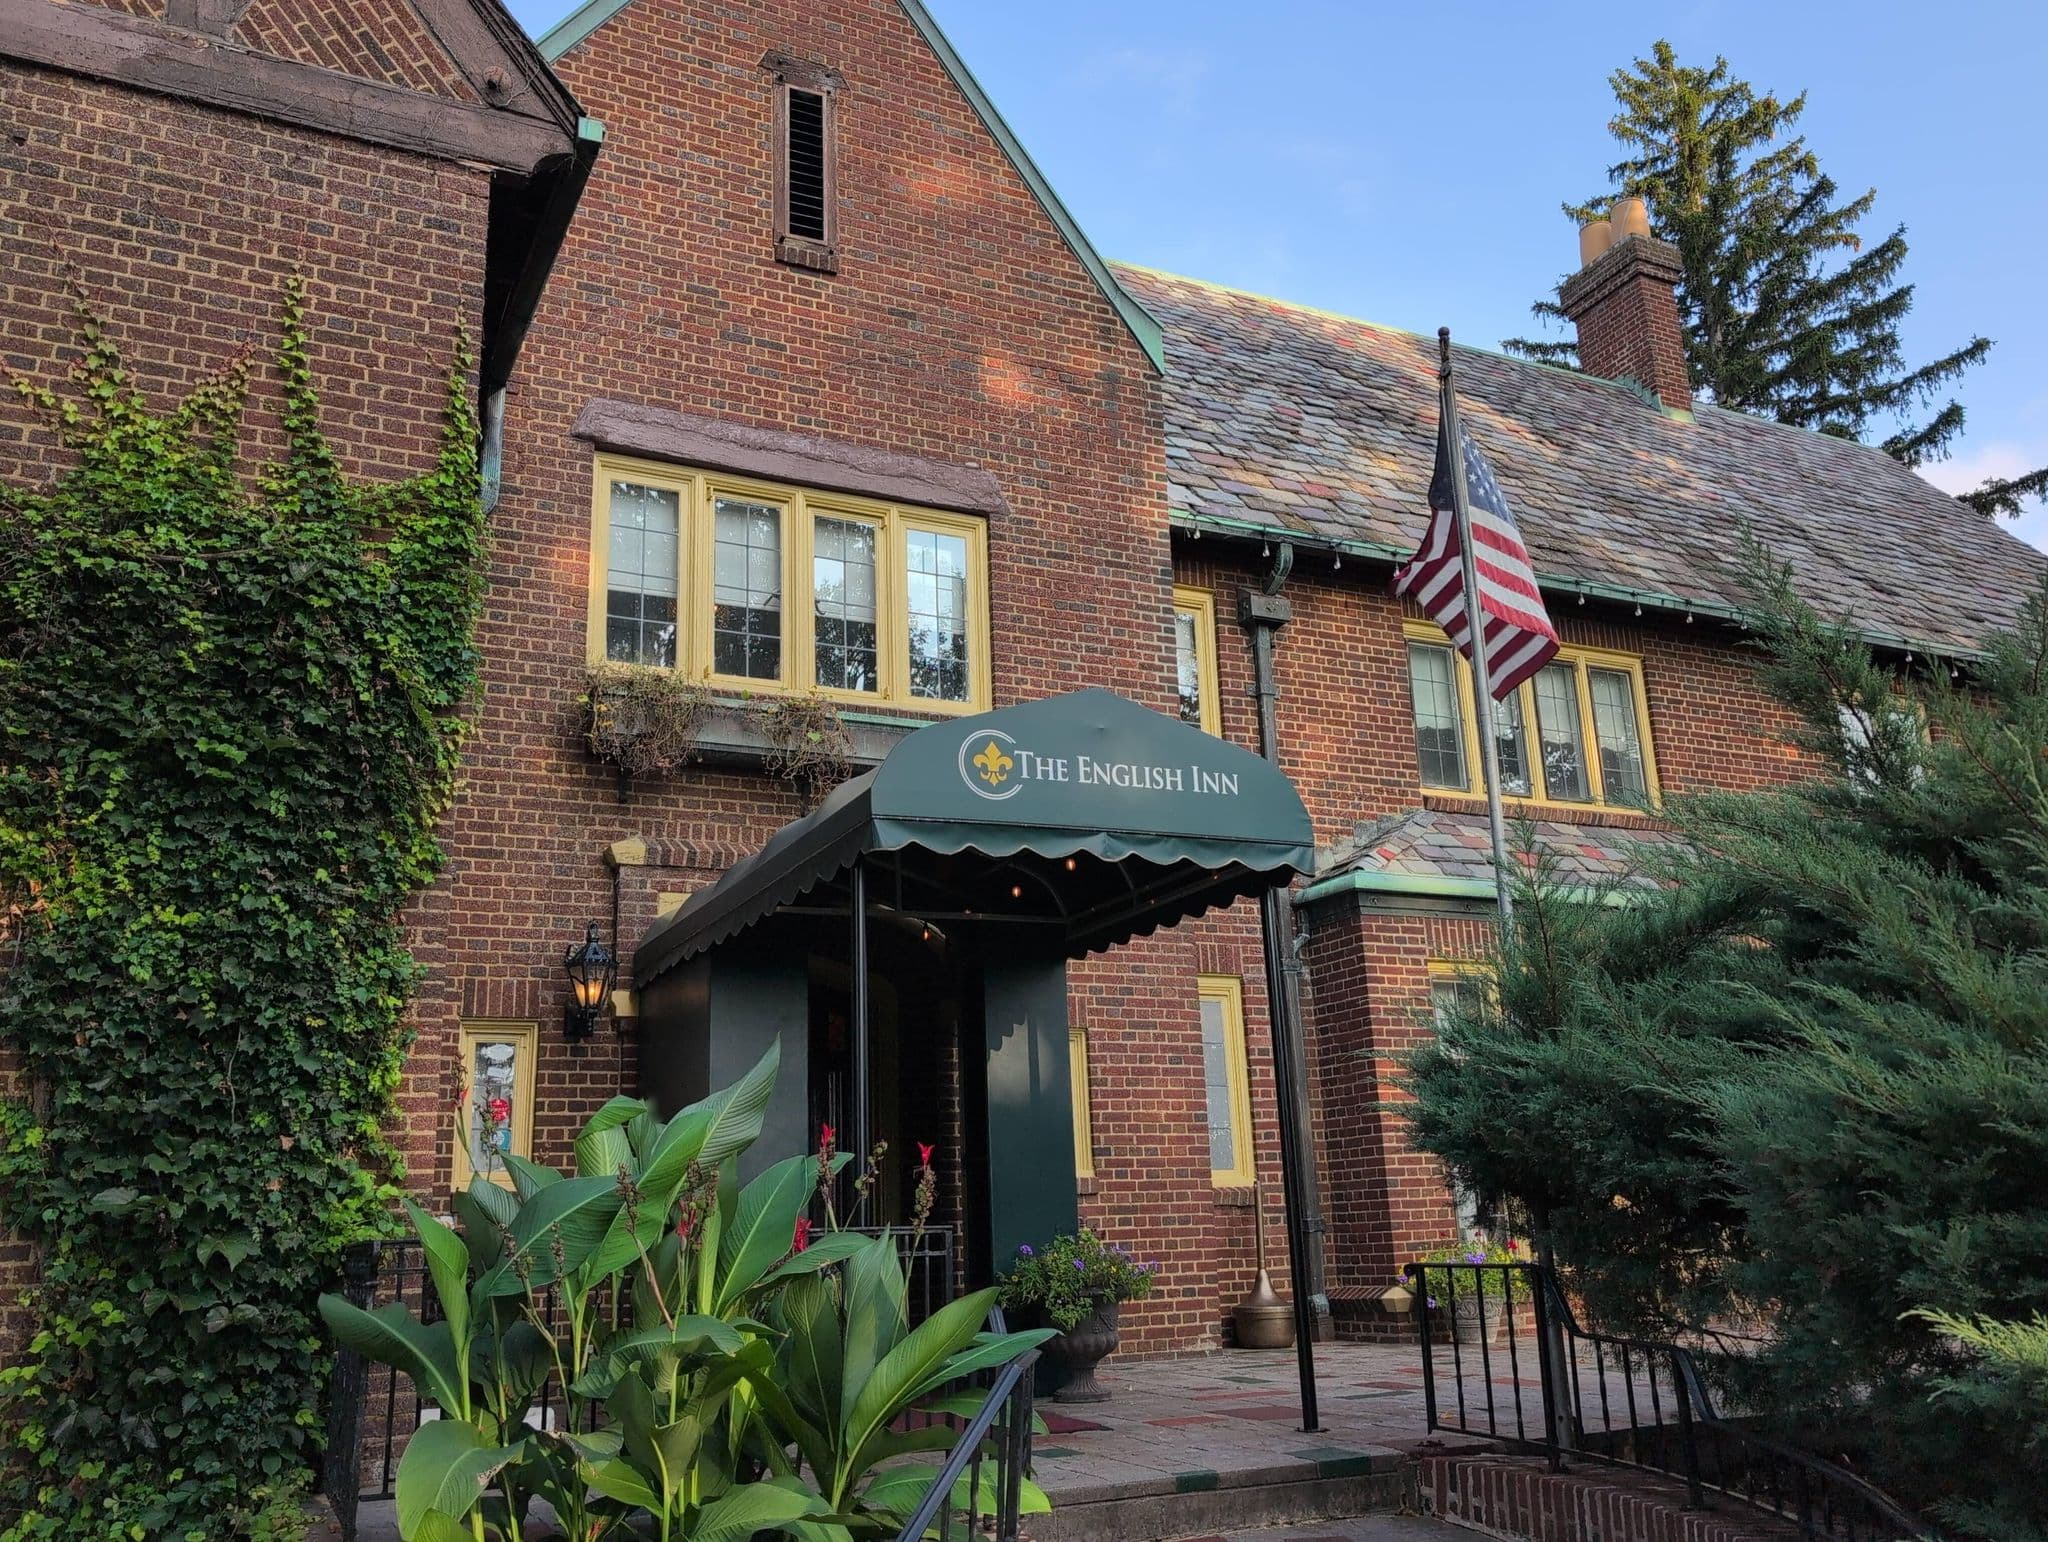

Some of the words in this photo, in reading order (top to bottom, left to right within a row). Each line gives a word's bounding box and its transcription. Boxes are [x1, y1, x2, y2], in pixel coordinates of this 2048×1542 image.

[1014, 750, 1069, 782] THE
[1076, 755, 1184, 791] ENGLISH
[1191, 765, 1239, 795] INN
